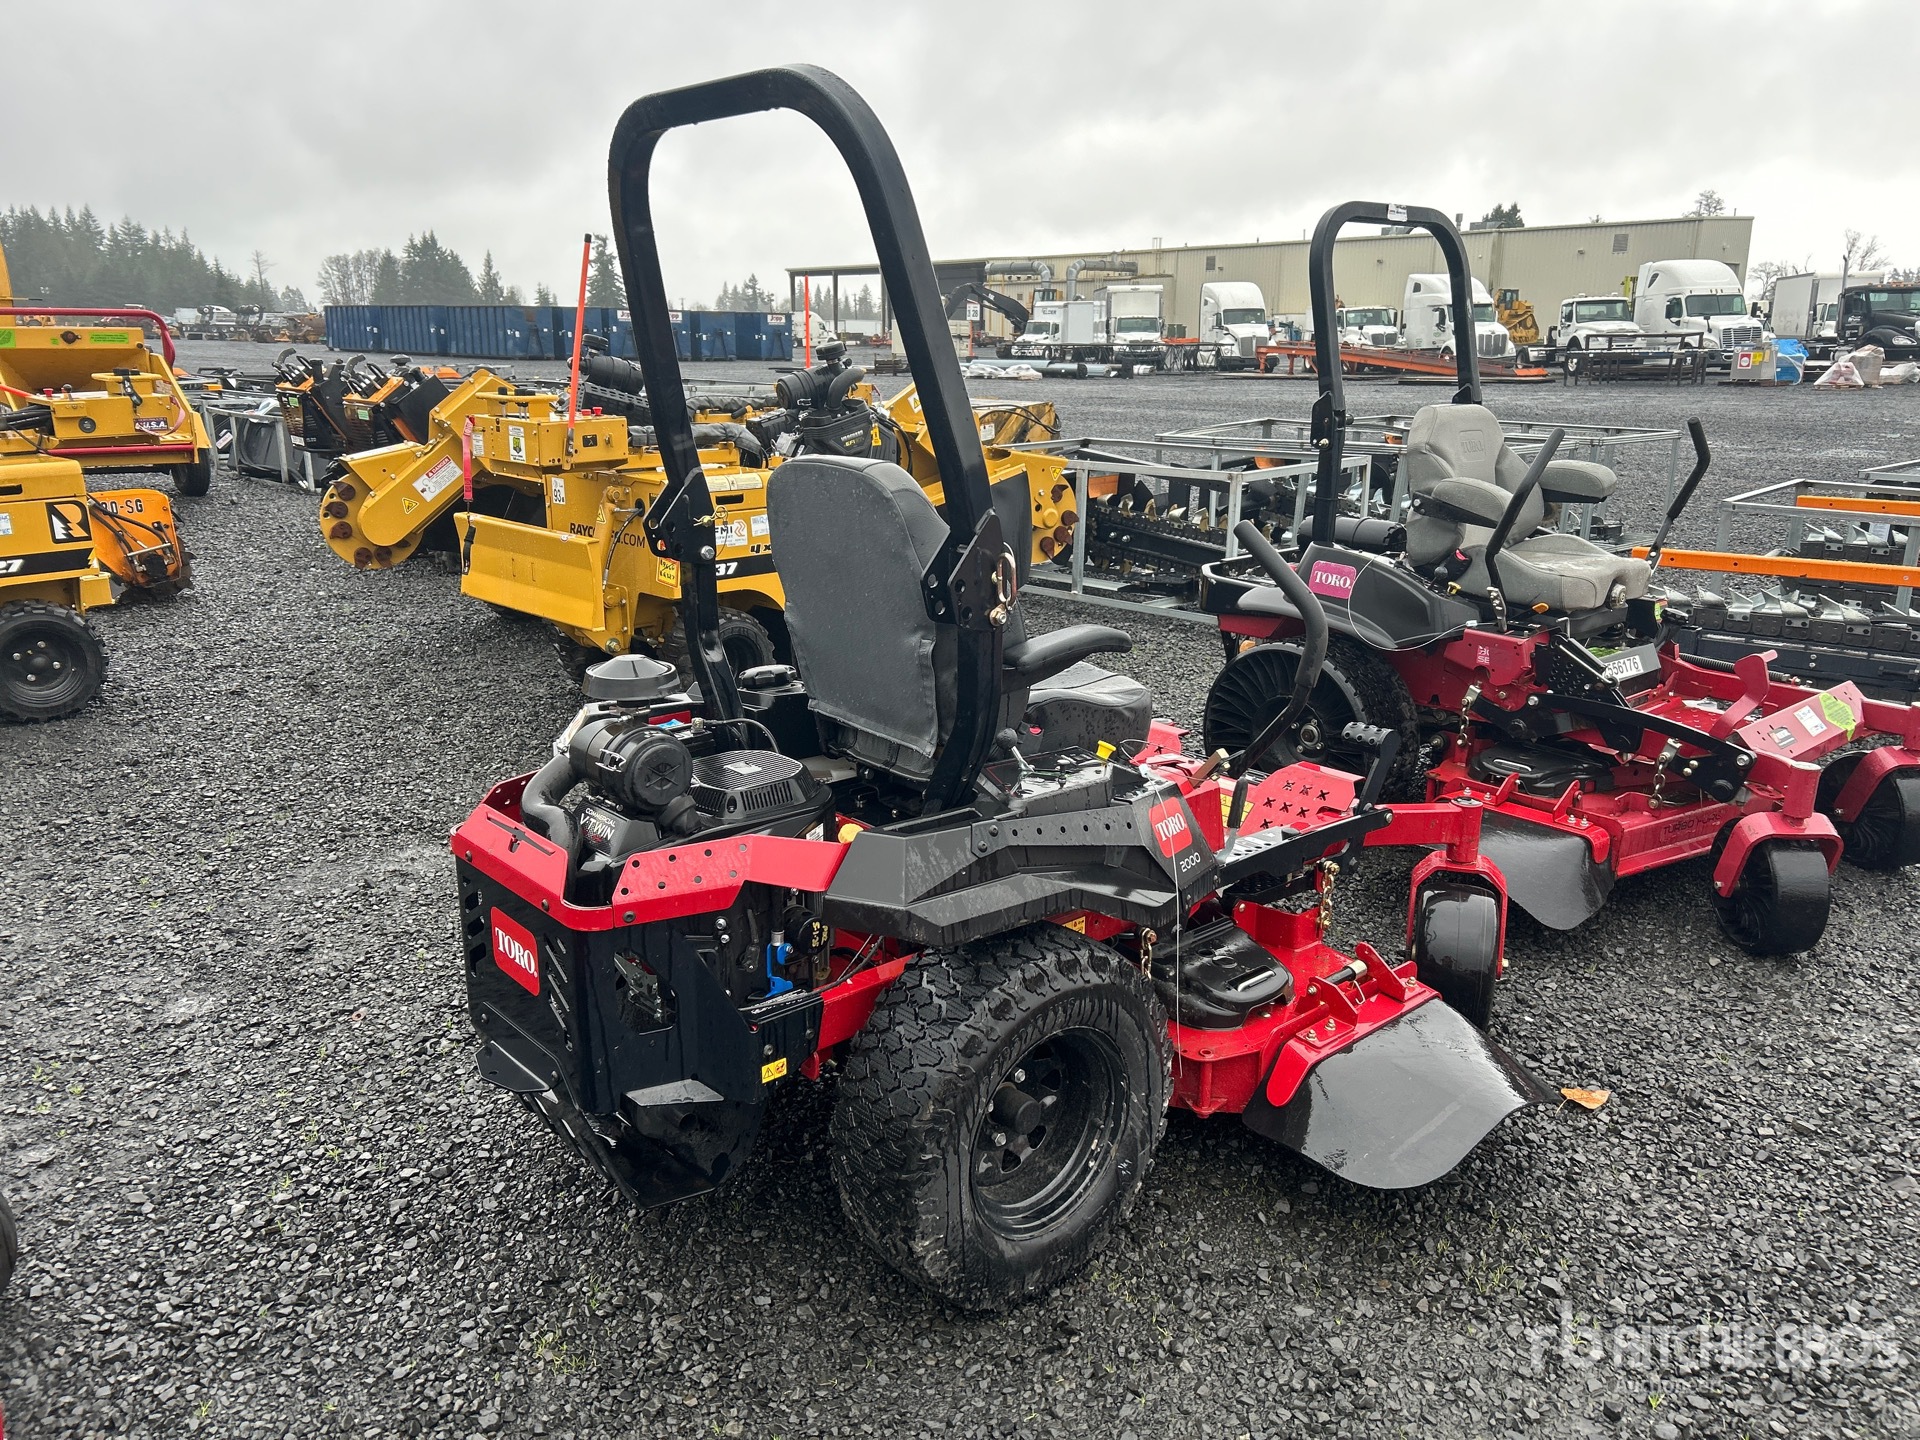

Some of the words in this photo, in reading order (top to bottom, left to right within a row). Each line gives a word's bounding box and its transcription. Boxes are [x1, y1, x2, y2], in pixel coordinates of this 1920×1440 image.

[431, 456, 450, 473] DANGER
[1314, 570, 1351, 589] TORO
[585, 807, 616, 828] COMMERCIAL
[1155, 812, 1186, 842] TORO
[1663, 819, 1695, 834] TURBO
[1179, 851, 1201, 873] 2000
[494, 926, 536, 975] TORO
